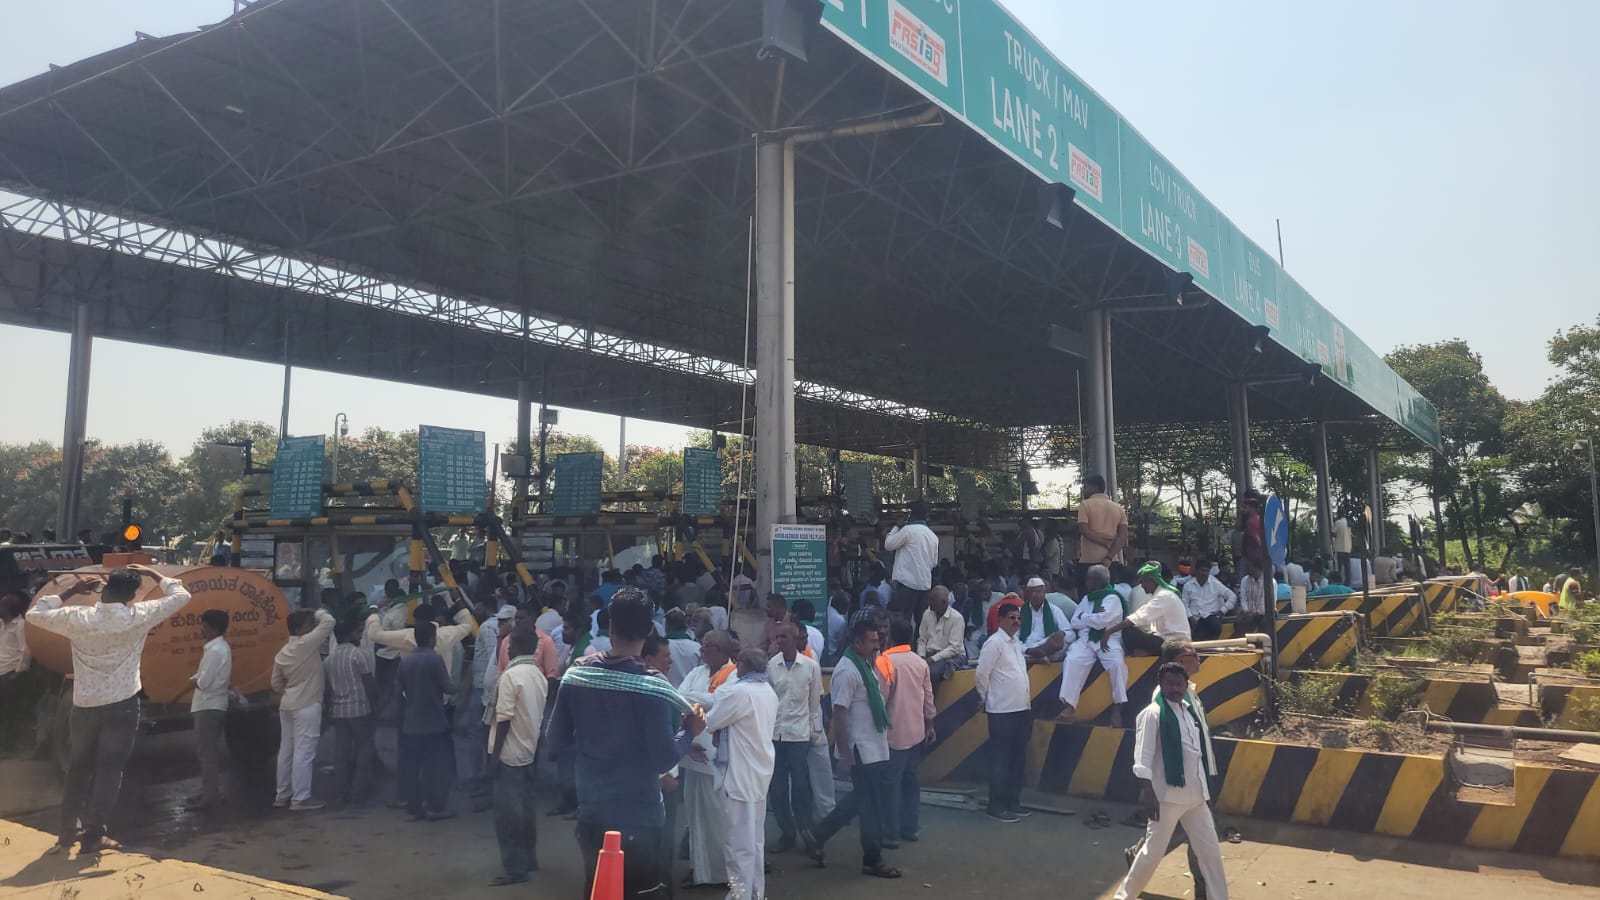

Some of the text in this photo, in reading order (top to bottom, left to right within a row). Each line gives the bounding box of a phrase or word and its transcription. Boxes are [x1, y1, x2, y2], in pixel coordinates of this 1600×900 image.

[1004, 30, 1089, 130] TRUCK / MAV
[990, 75, 1059, 172] LANE 2
[1149, 160, 1165, 195] LCV
[1172, 180, 1198, 225] TRUCK
[1140, 196, 1173, 253] LANE
[1174, 223, 1182, 260] 3
[1233, 271, 1255, 313] LANE
